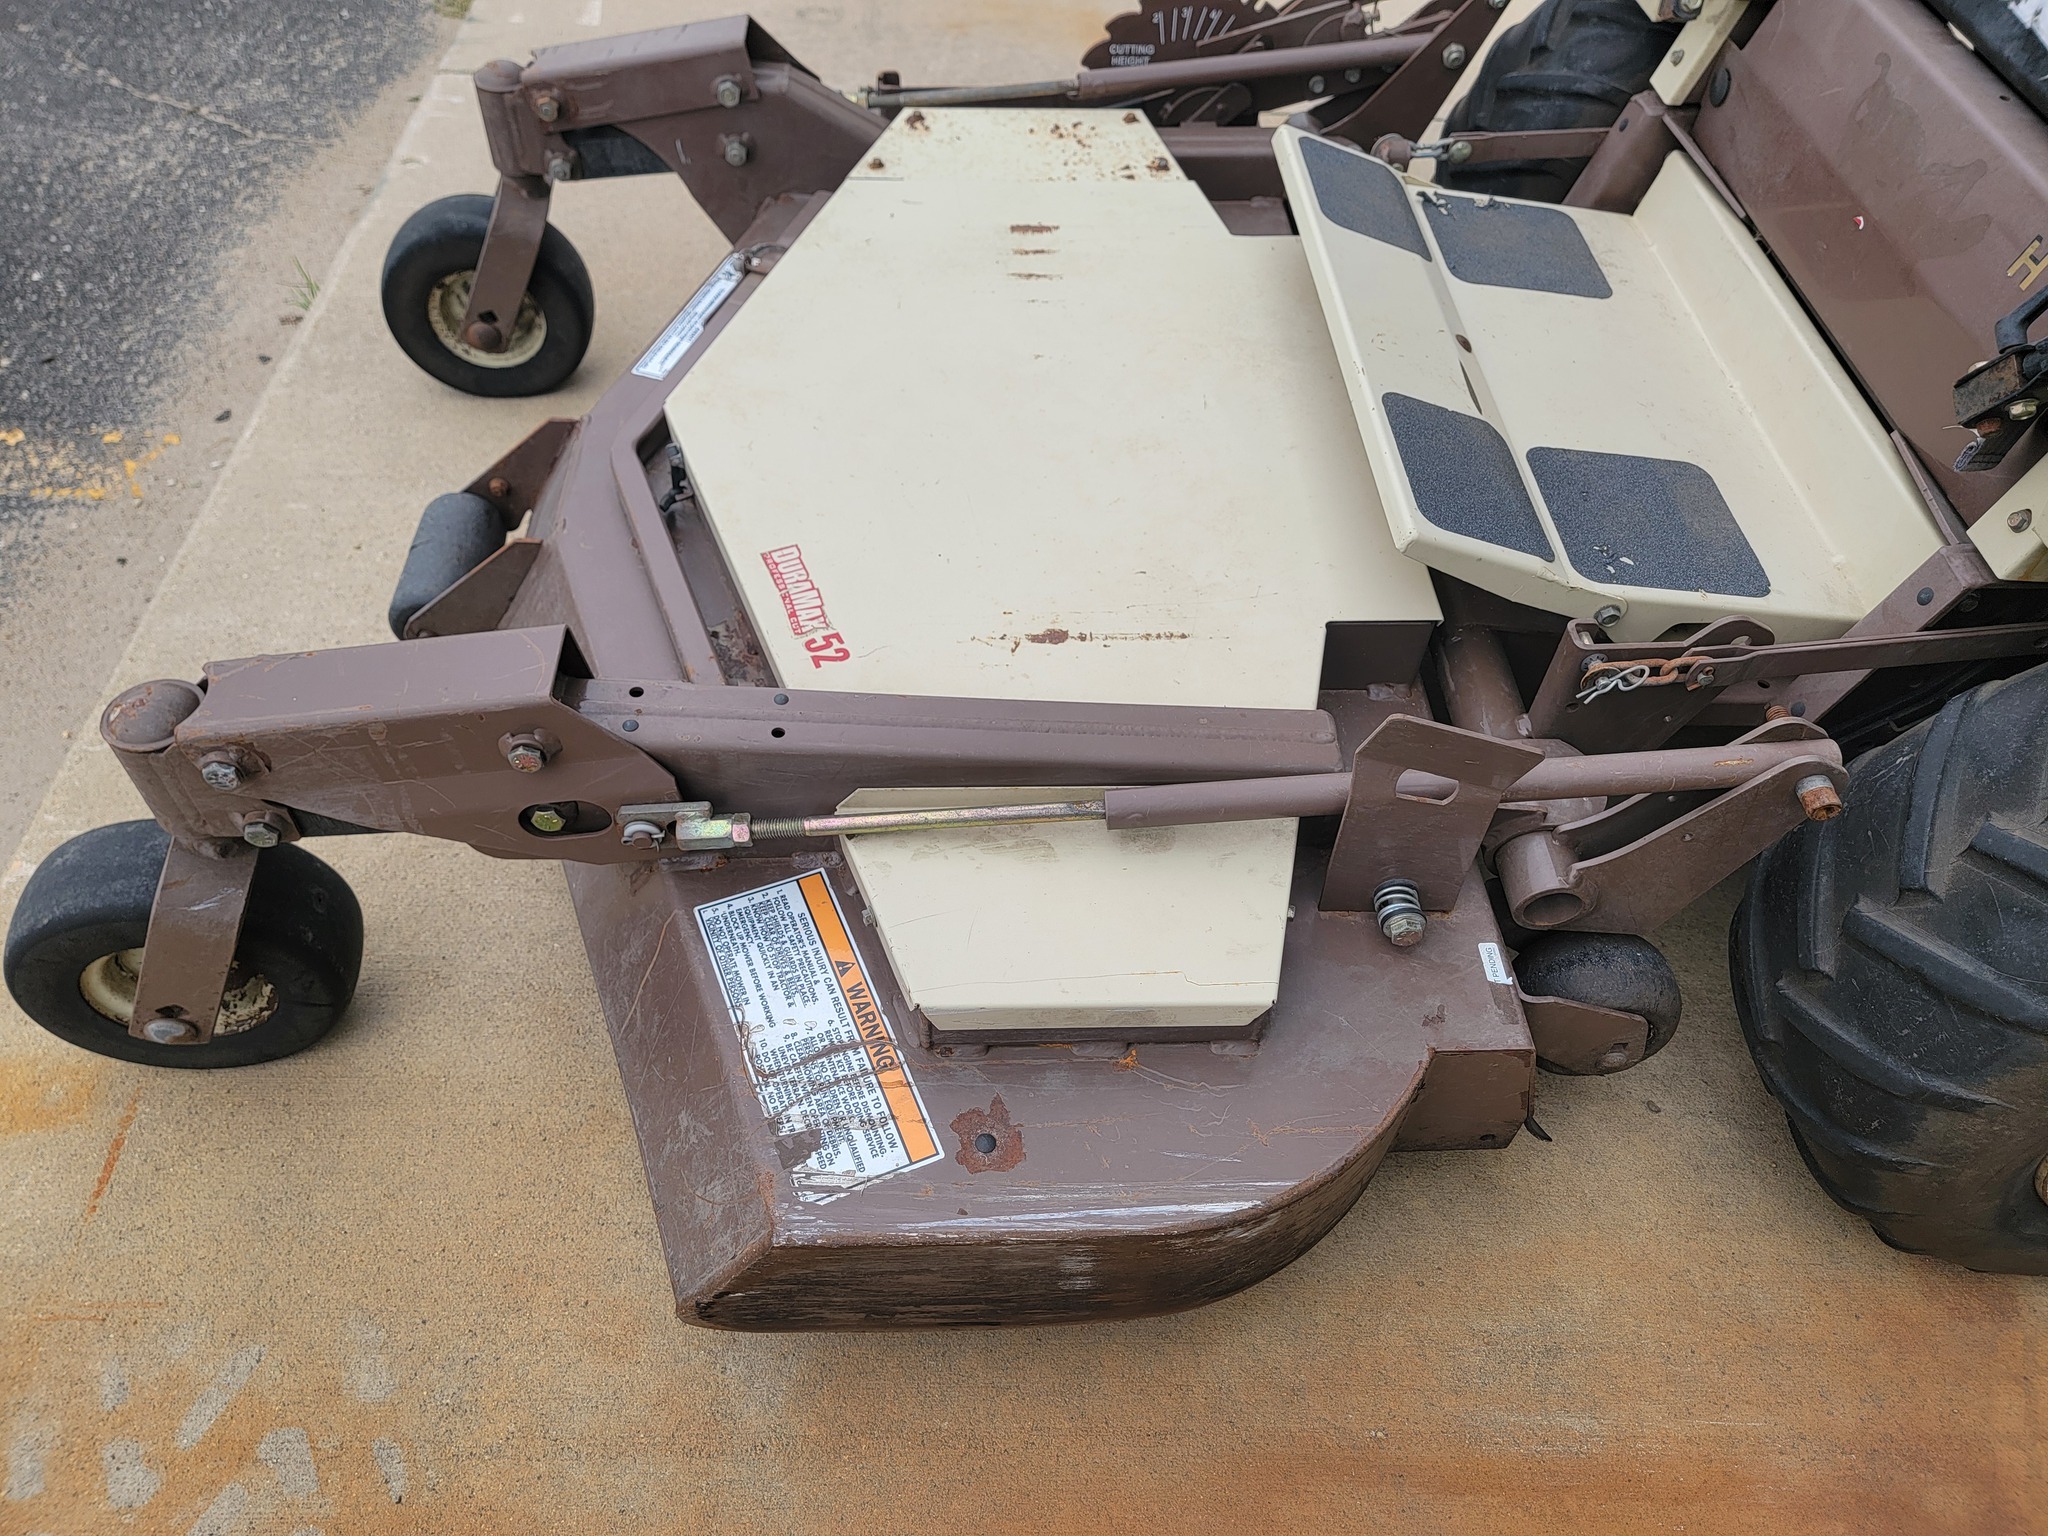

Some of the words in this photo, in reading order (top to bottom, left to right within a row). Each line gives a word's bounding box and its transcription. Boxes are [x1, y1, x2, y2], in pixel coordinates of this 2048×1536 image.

[1109, 44, 1155, 55] CUTTING
[1111, 56, 1151, 66] HEIGHT
[770, 544, 830, 635] DURAMAX
[804, 632, 850, 669] 52
[750, 902, 763, 924] KNOW
[757, 900, 768, 916] KEEP
[764, 898, 775, 914] KEEP
[772, 896, 787, 922] FOLLOW
[705, 916, 720, 944] VICINITY
[712, 914, 722, 925] DO
[727, 909, 740, 931] BLOCK
[735, 907, 755, 947] EMERGENCY.
[742, 905, 761, 941] EQUIPMENT
[763, 916, 776, 935] CLEAR
[770, 914, 785, 939] SHIELDS
[782, 922, 792, 934] ALL
[796, 911, 817, 946] SERIOUS
[716, 925, 727, 940] NOT
[720, 912, 741, 956] UNDERNEATH.
[735, 931, 744, 941] UP
[758, 924, 770, 942] HOW
[770, 936, 780, 946] OF
[779, 893, 791, 910] READ
[785, 910, 806, 949] OPERATOR'S
[801, 949, 818, 979] MANUAL
[714, 944, 724, 954] OF
[722, 940, 737, 969] OPERATE
[739, 941, 754, 967] MOWER
[755, 941, 772, 970] QUICKLY
[764, 942, 774, 952] TO
[786, 934, 801, 957] SAFETY
[718, 954, 731, 976] OTHER
[768, 953, 781, 970] STOP
[774, 946, 788, 969] DRIVES
[782, 945, 798, 973] GUARDS
[810, 946, 829, 976] INJURY
[1486, 948, 1499, 977] PENDING
[732, 969, 747, 996] MOWER
[748, 967, 763, 992] BEFORE
[766, 970, 775, 979] IN
[769, 979, 780, 991] AN
[775, 970, 792, 1001] TRACTOR
[793, 973, 802, 982] IN
[795, 957, 819, 1005] PRECAUTIONS.
[822, 976, 837, 995] CAN
[786, 976, 799, 997] BELTS.
[796, 983, 811, 1006] PLACE.
[741, 996, 750, 1006] IN
[757, 992, 776, 1029] WORKING
[830, 995, 850, 1029] RESULT
[808, 1034, 821, 1055] ALLO
[816, 1031, 826, 1043] OR
[843, 1029, 861, 1056] FRM
[769, 1047, 782, 1071] WHEN
[818, 1060, 828, 1073] NO
[840, 1048, 855, 1072] NGINE
[761, 1051, 771, 1063] DO
[771, 1080, 788, 1113] OPERAT
[783, 1113, 792, 1123] IN
[776, 1045, 793, 1075] UNEVEN
[787, 1075, 805, 1109] TERRAN.
[812, 1070, 822, 1081] TO
[766, 1091, 776, 1104] NO
[816, 1081, 828, 1098] RUN
[823, 1073, 842, 1109] CHLDREN
[823, 1029, 841, 1059] REME
[835, 1059, 846, 1073] KEY
[851, 1101, 867, 1128] DOING
[861, 1128, 879, 1159] SERVICE
[784, 1042, 794, 1053] BE
[824, 1151, 835, 1166] ON
[869, 1095, 882, 1109] TO
[823, 1099, 845, 1145] EQUPMENT.
[836, 1109, 847, 1122] OR
[813, 1097, 826, 1117] AREA
[825, 1129, 842, 1159] DEBRIS.
[875, 1110, 899, 1152] FOLLOW.
[841, 1122, 866, 1173] UNQUALIFIED
